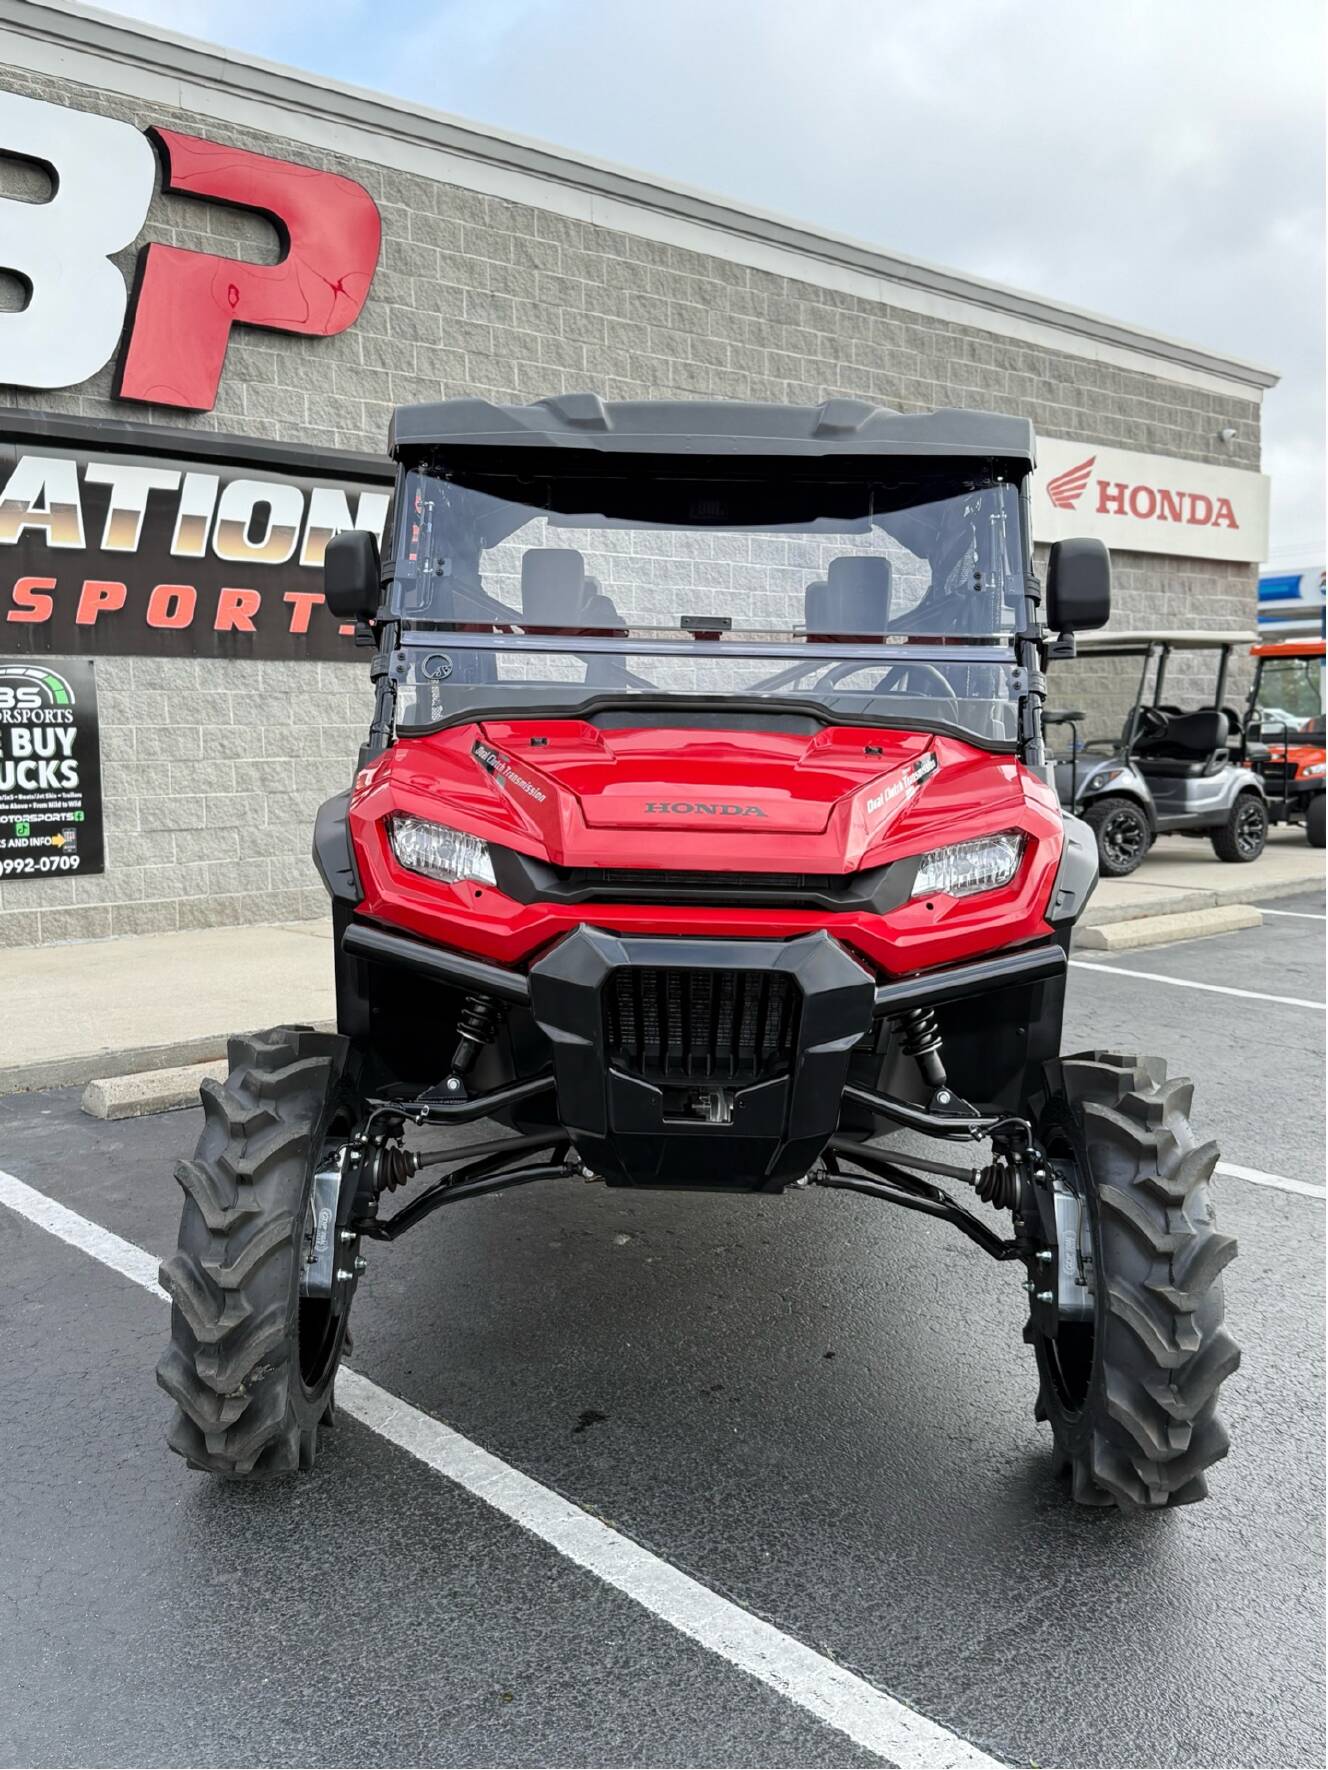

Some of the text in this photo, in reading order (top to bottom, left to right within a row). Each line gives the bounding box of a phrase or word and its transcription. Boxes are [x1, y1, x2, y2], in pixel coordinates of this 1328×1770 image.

[1096, 480, 1239, 529] HONDA
[7, 576, 356, 635] SPORT
[0, 709, 73, 723] RSPORTS
[11, 727, 77, 757] BUY
[475, 746, 546, 802] Dual Clutch Transmission
[644, 802, 768, 817] HONDA
[867, 793, 885, 814] Dual
[8, 838, 28, 848] AND
[30, 836, 52, 847] INFO
